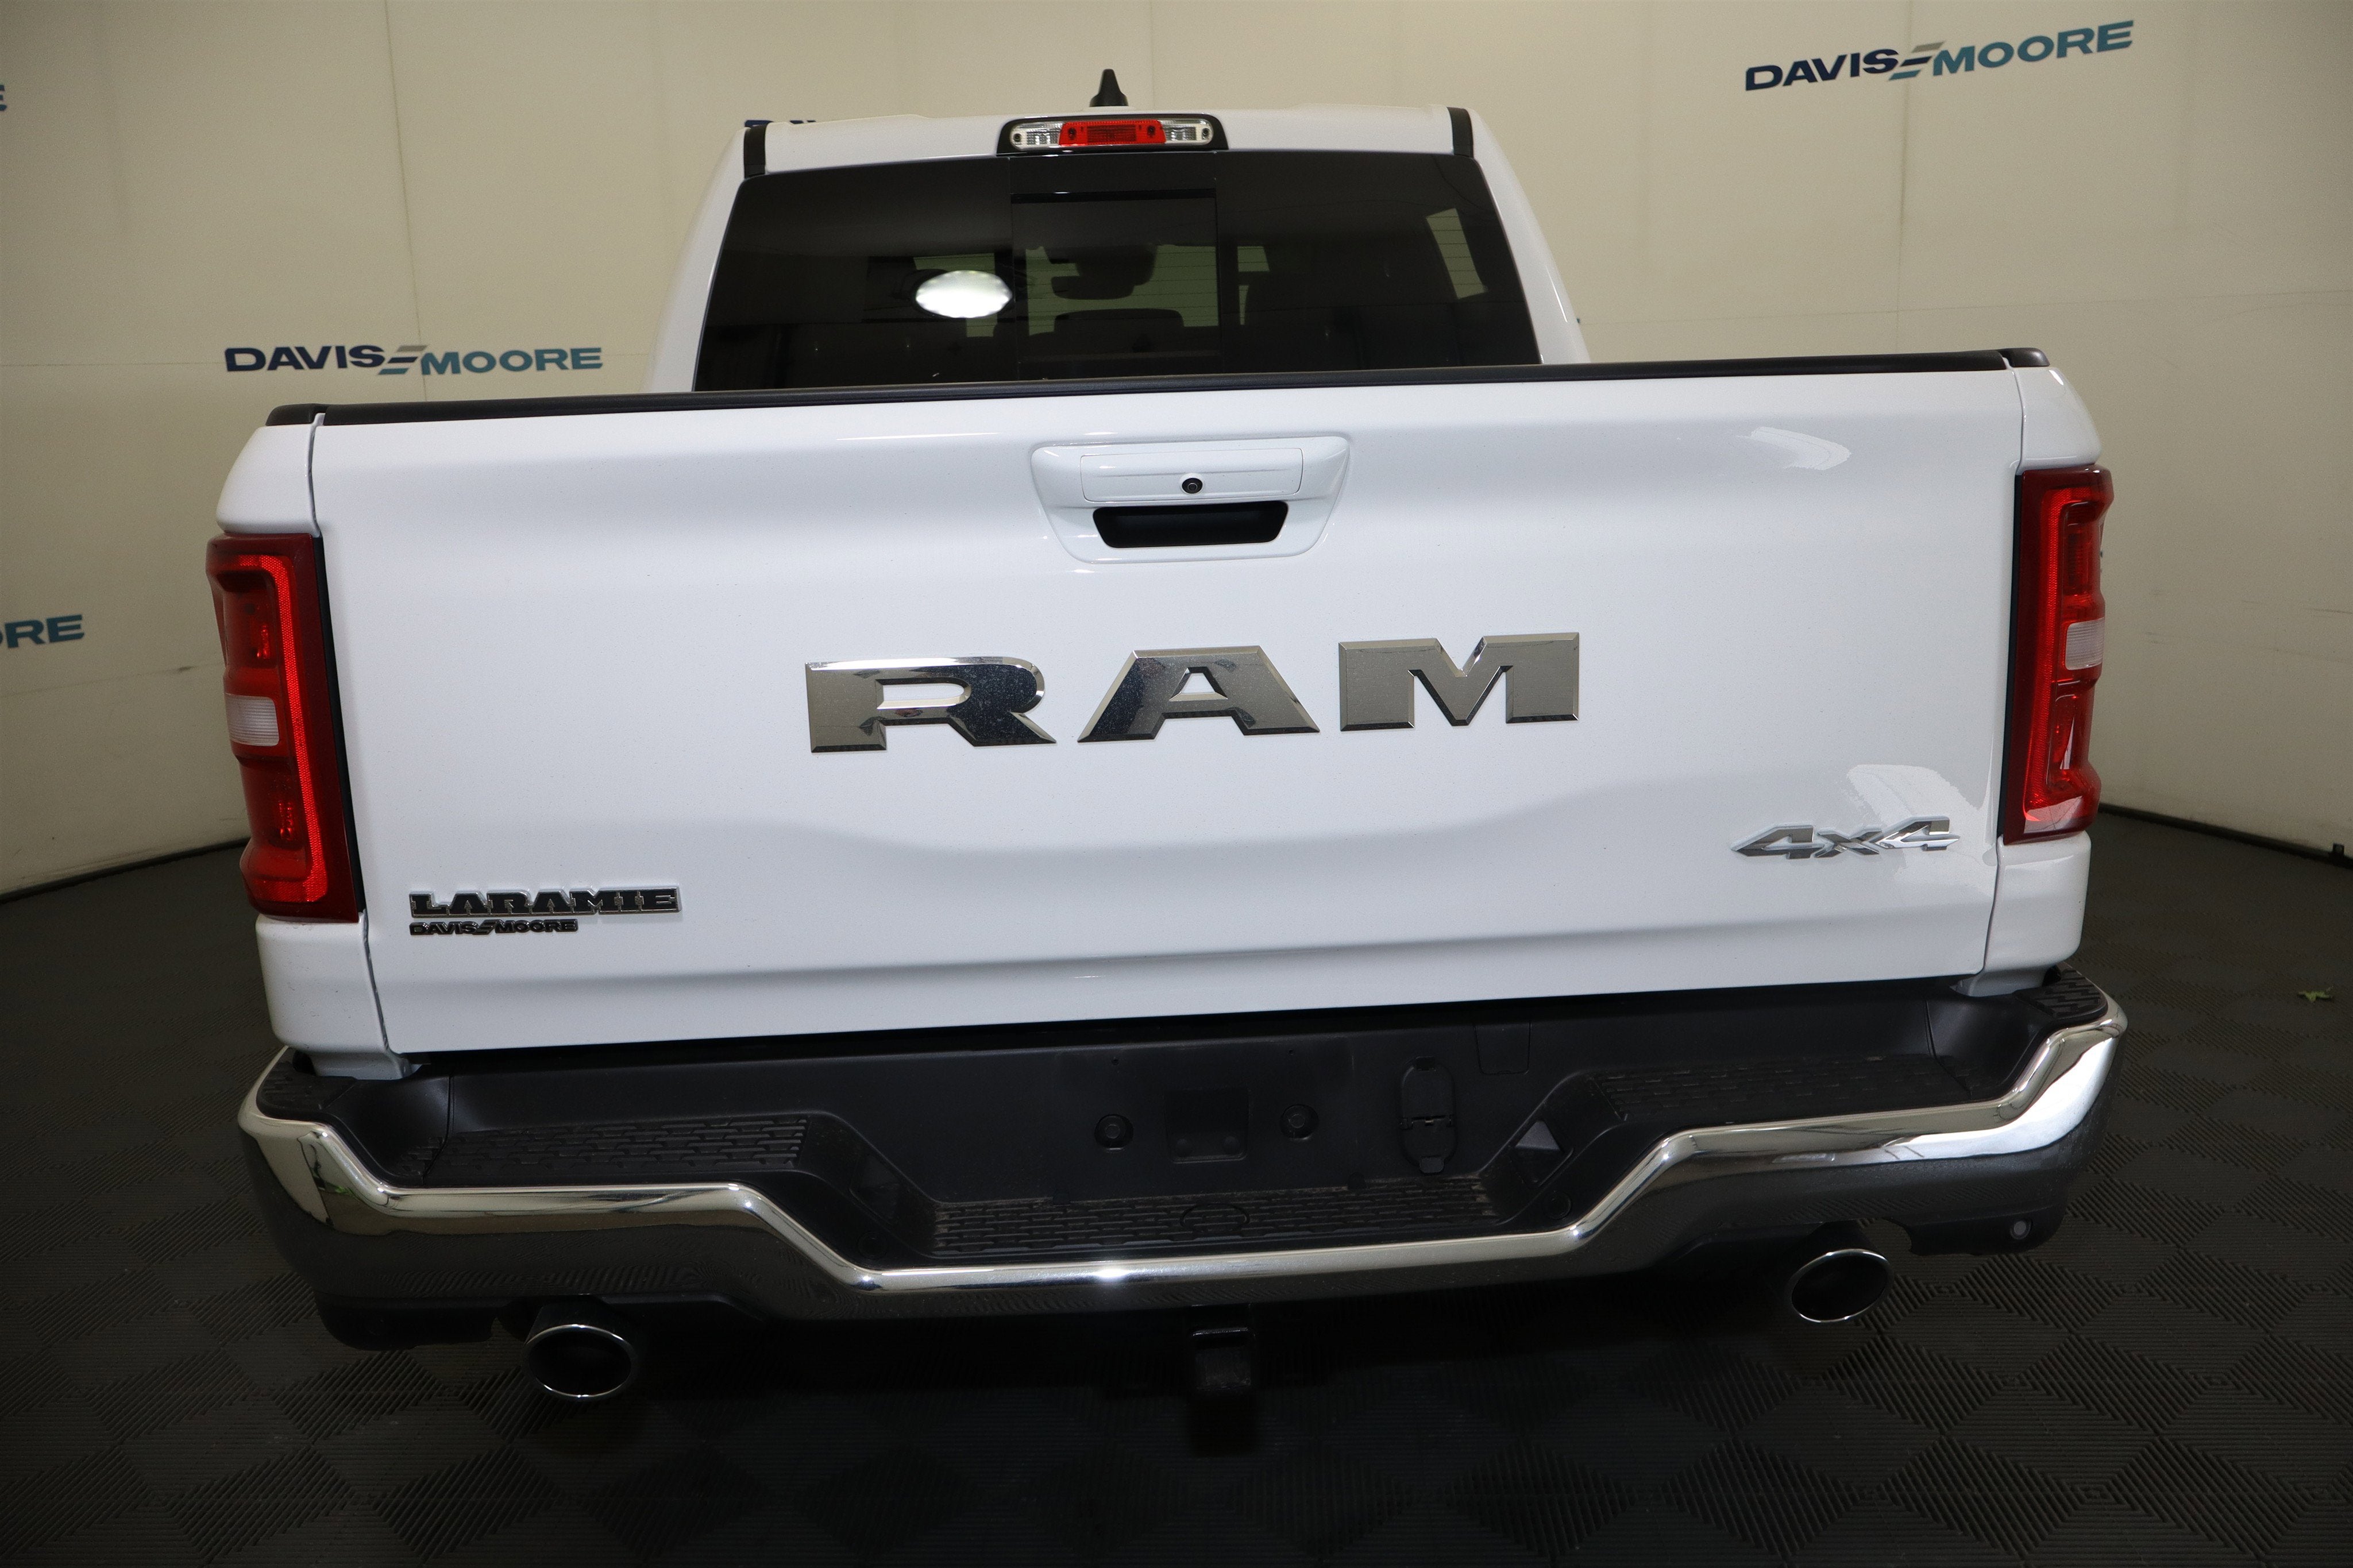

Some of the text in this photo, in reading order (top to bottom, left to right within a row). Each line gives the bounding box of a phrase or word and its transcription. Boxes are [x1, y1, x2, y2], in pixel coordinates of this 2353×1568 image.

[1745, 20, 2134, 91] DAVIS MOORE
[224, 345, 603, 375] DAVIS MOORE
[0, 614, 84, 648] RE
[805, 631, 1580, 753] RAM
[409, 885, 682, 918] LARAMIE
[409, 919, 578, 936] DAVIS MOORE
